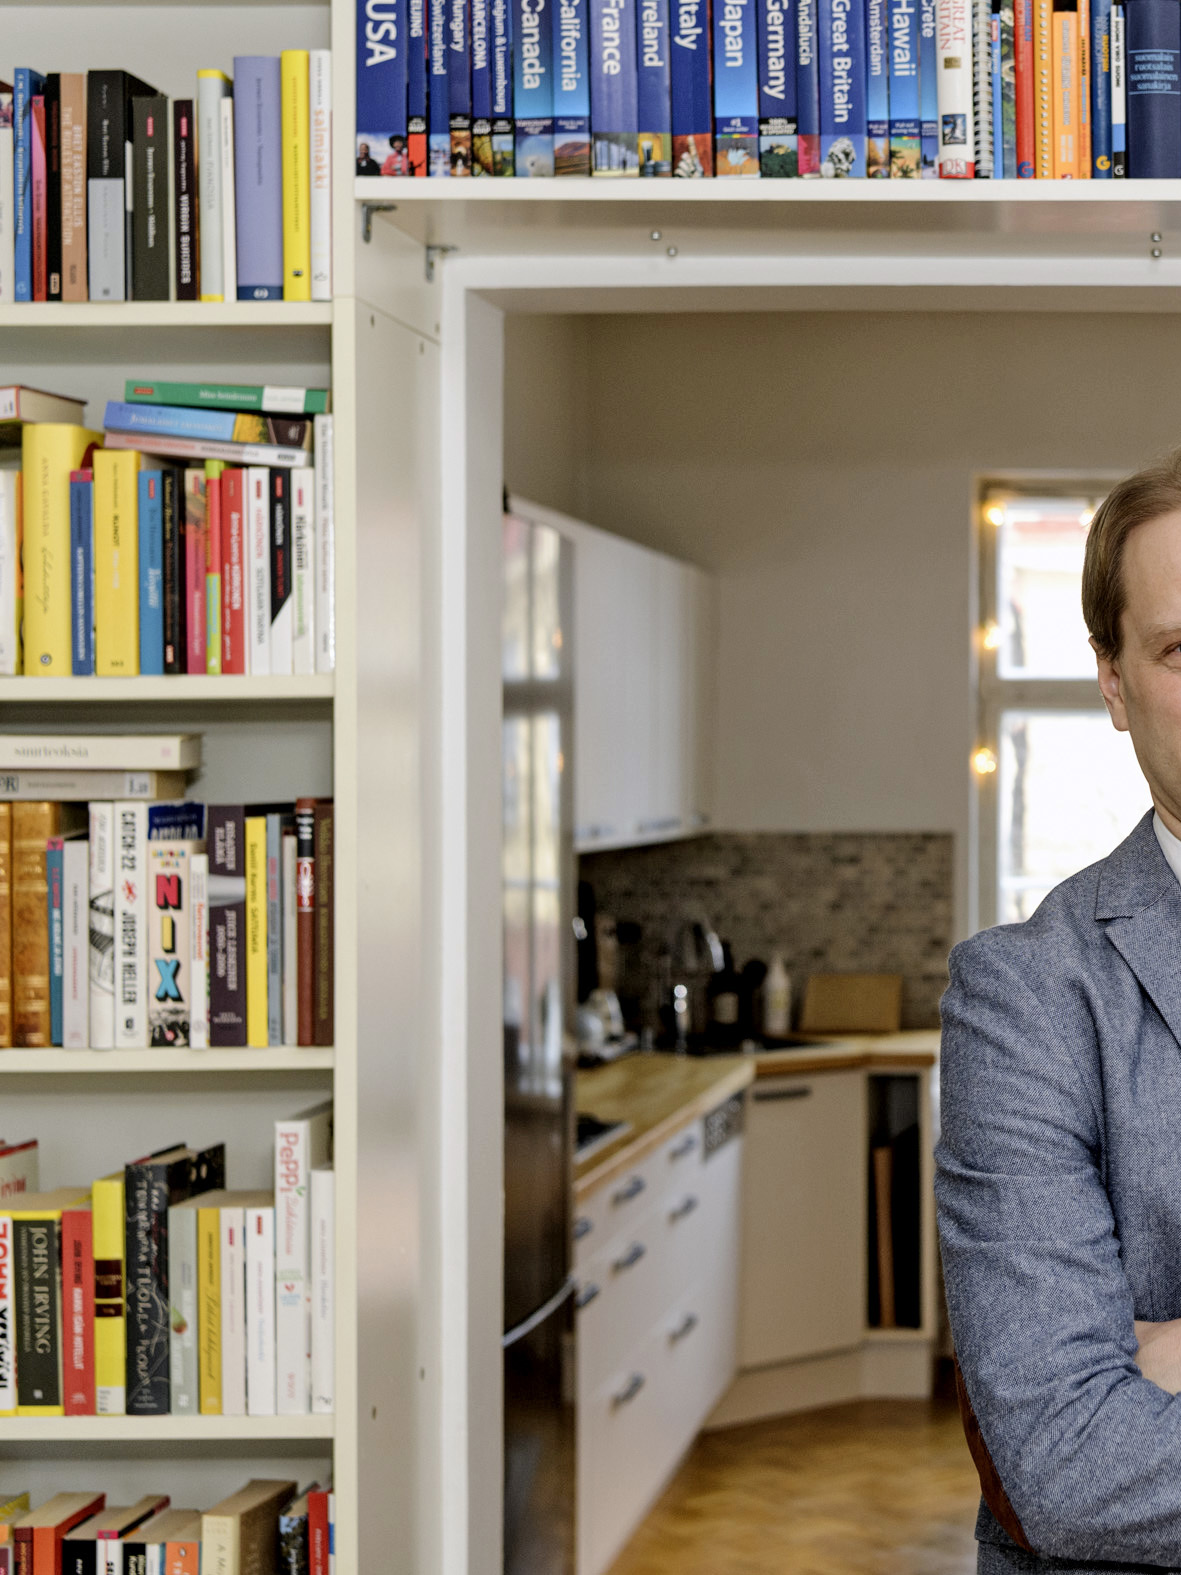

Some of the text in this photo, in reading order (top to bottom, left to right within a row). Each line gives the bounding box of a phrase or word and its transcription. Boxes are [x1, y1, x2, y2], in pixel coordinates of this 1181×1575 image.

[365, 0, 397, 67] USA
[432, 0, 447, 75] Switzerland
[521, 0, 545, 89] Canada
[560, 0, 581, 91] California
[602, 0, 625, 75] France
[674, 0, 703, 50] Italy
[719, 0, 748, 67] Japan
[763, 0, 788, 100] Germany
[869, 0, 884, 75] Amsterdam
[892, 0, 916, 77] Hawaii
[922, 0, 936, 38] Crete
[494, 47, 507, 113] Luxembourg
[831, 0, 853, 123] Great Britain
[314, 109, 328, 189] salmiakki
[121, 811, 137, 1006] CATCH-22 JOSEPH HELLER
[279, 1131, 300, 1193] Peppi
[29, 1227, 51, 1355] JOHN IRVING
